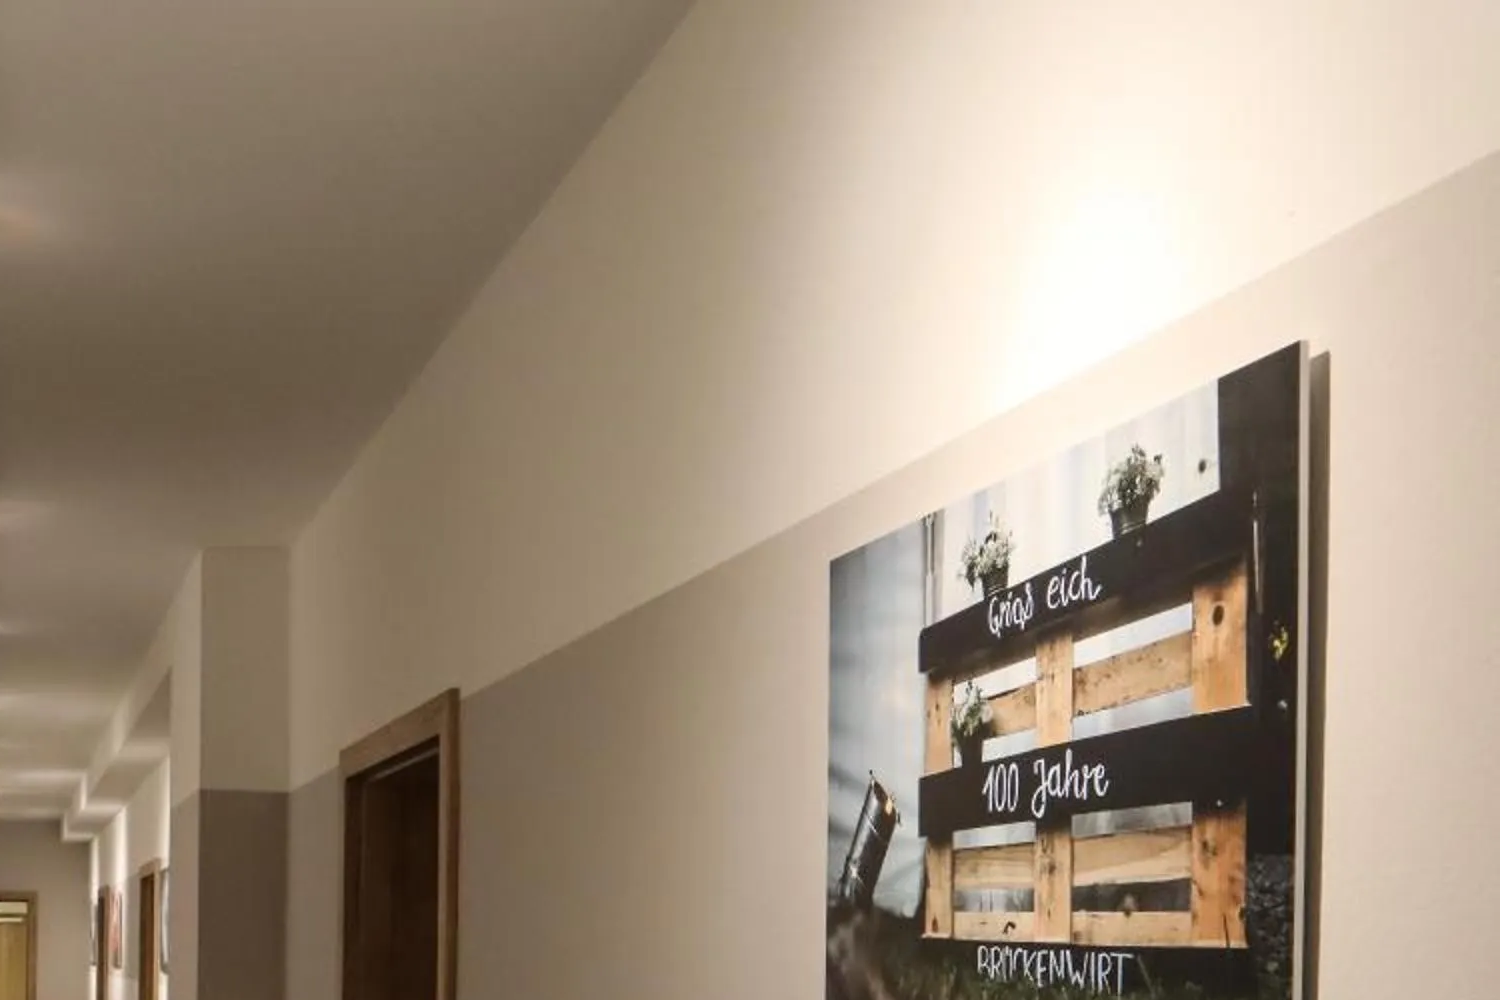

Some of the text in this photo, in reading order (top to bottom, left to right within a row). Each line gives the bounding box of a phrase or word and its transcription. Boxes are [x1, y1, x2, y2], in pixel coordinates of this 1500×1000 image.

[1047, 554, 1102, 609] eich
[982, 748, 1109, 819] 100 Jahre
